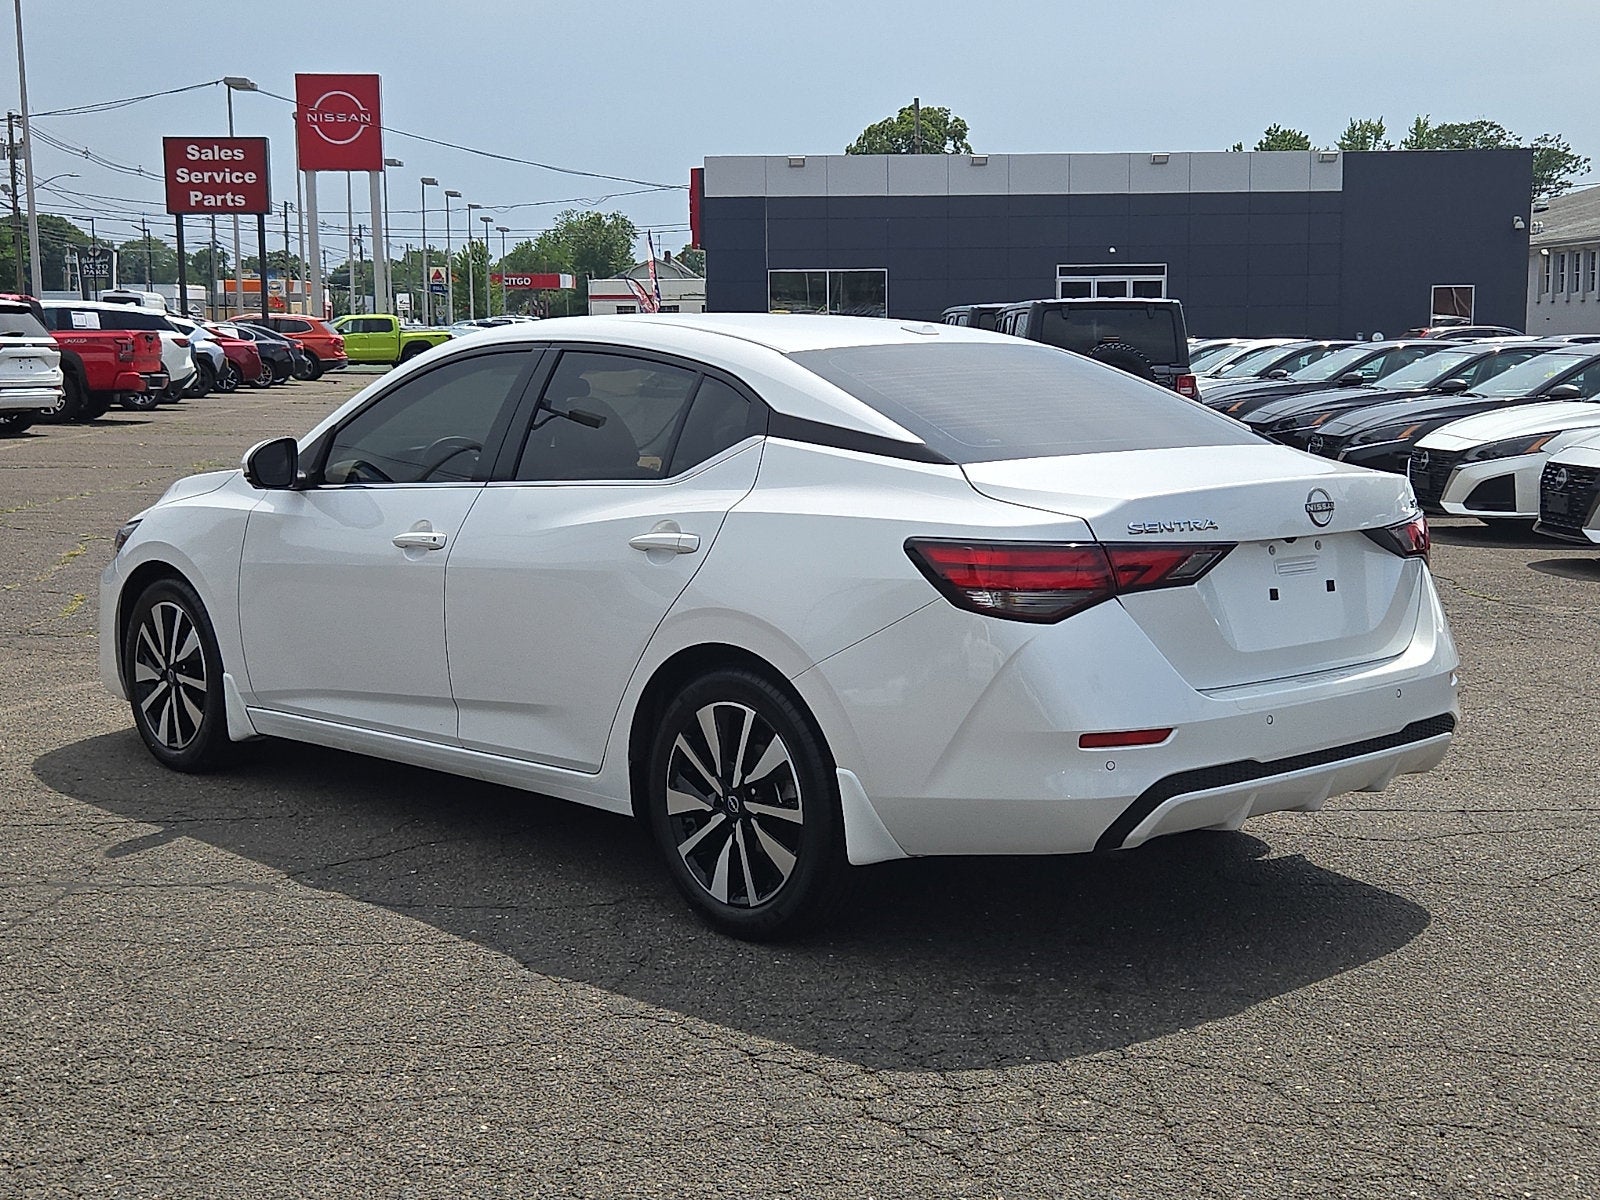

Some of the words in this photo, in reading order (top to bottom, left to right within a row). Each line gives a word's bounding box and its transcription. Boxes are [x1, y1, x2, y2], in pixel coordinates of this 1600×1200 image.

[306, 113, 371, 122] NISSAN
[186, 144, 245, 161] Sales
[176, 167, 257, 184] Service
[189, 190, 246, 207] Parts
[1305, 502, 1335, 512] NISSAN
[1127, 518, 1219, 535] SENTRA
